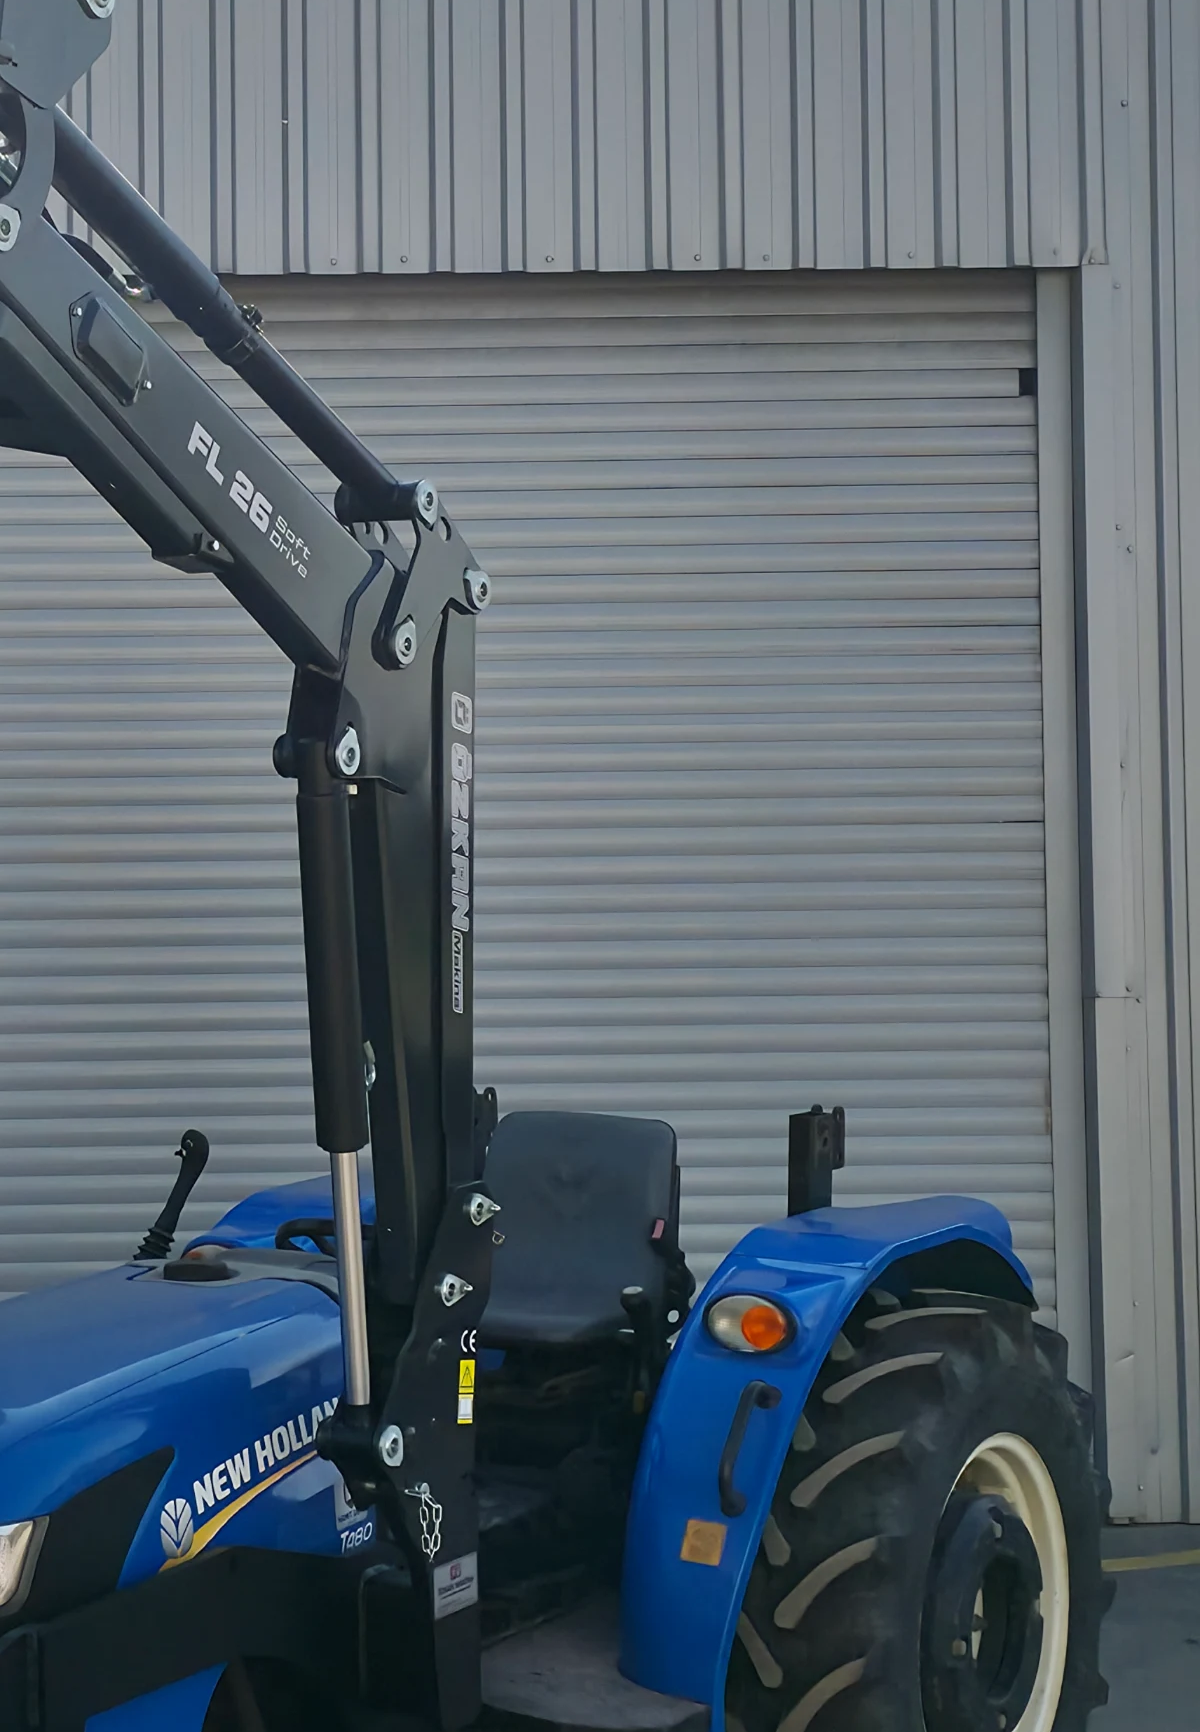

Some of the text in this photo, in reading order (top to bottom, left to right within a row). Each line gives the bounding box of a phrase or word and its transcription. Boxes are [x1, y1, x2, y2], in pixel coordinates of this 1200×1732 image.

[187, 421, 273, 534] FL 26
[269, 529, 308, 579] Drive
[275, 515, 311, 561] Soft
[453, 934, 461, 1010] Makina
[460, 1329, 477, 1353] CE
[193, 1397, 339, 1515] NEW HOLLAN
